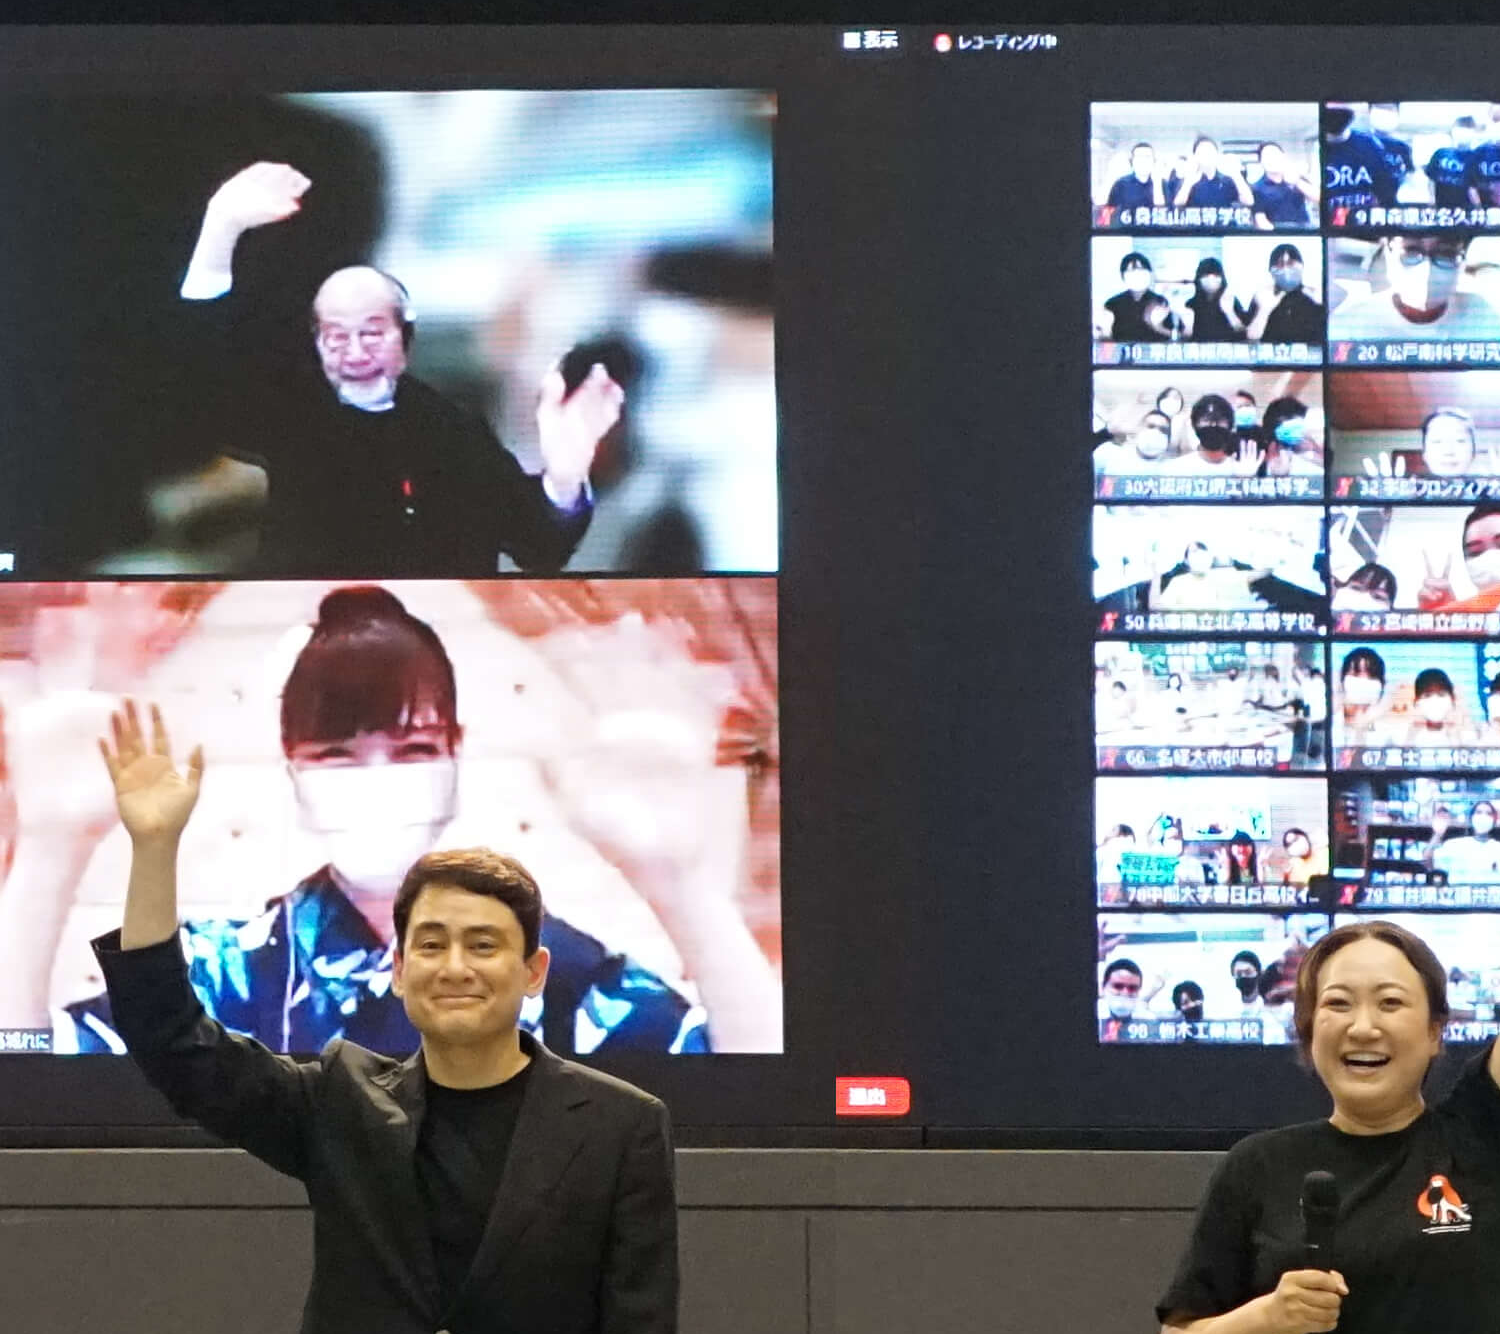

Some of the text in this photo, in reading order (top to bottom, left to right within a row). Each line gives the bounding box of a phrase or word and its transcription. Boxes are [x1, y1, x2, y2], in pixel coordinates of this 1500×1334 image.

[864, 30, 899, 49] 表示
[958, 34, 1058, 51] レコーディング中
[1120, 208, 1131, 225] 6
